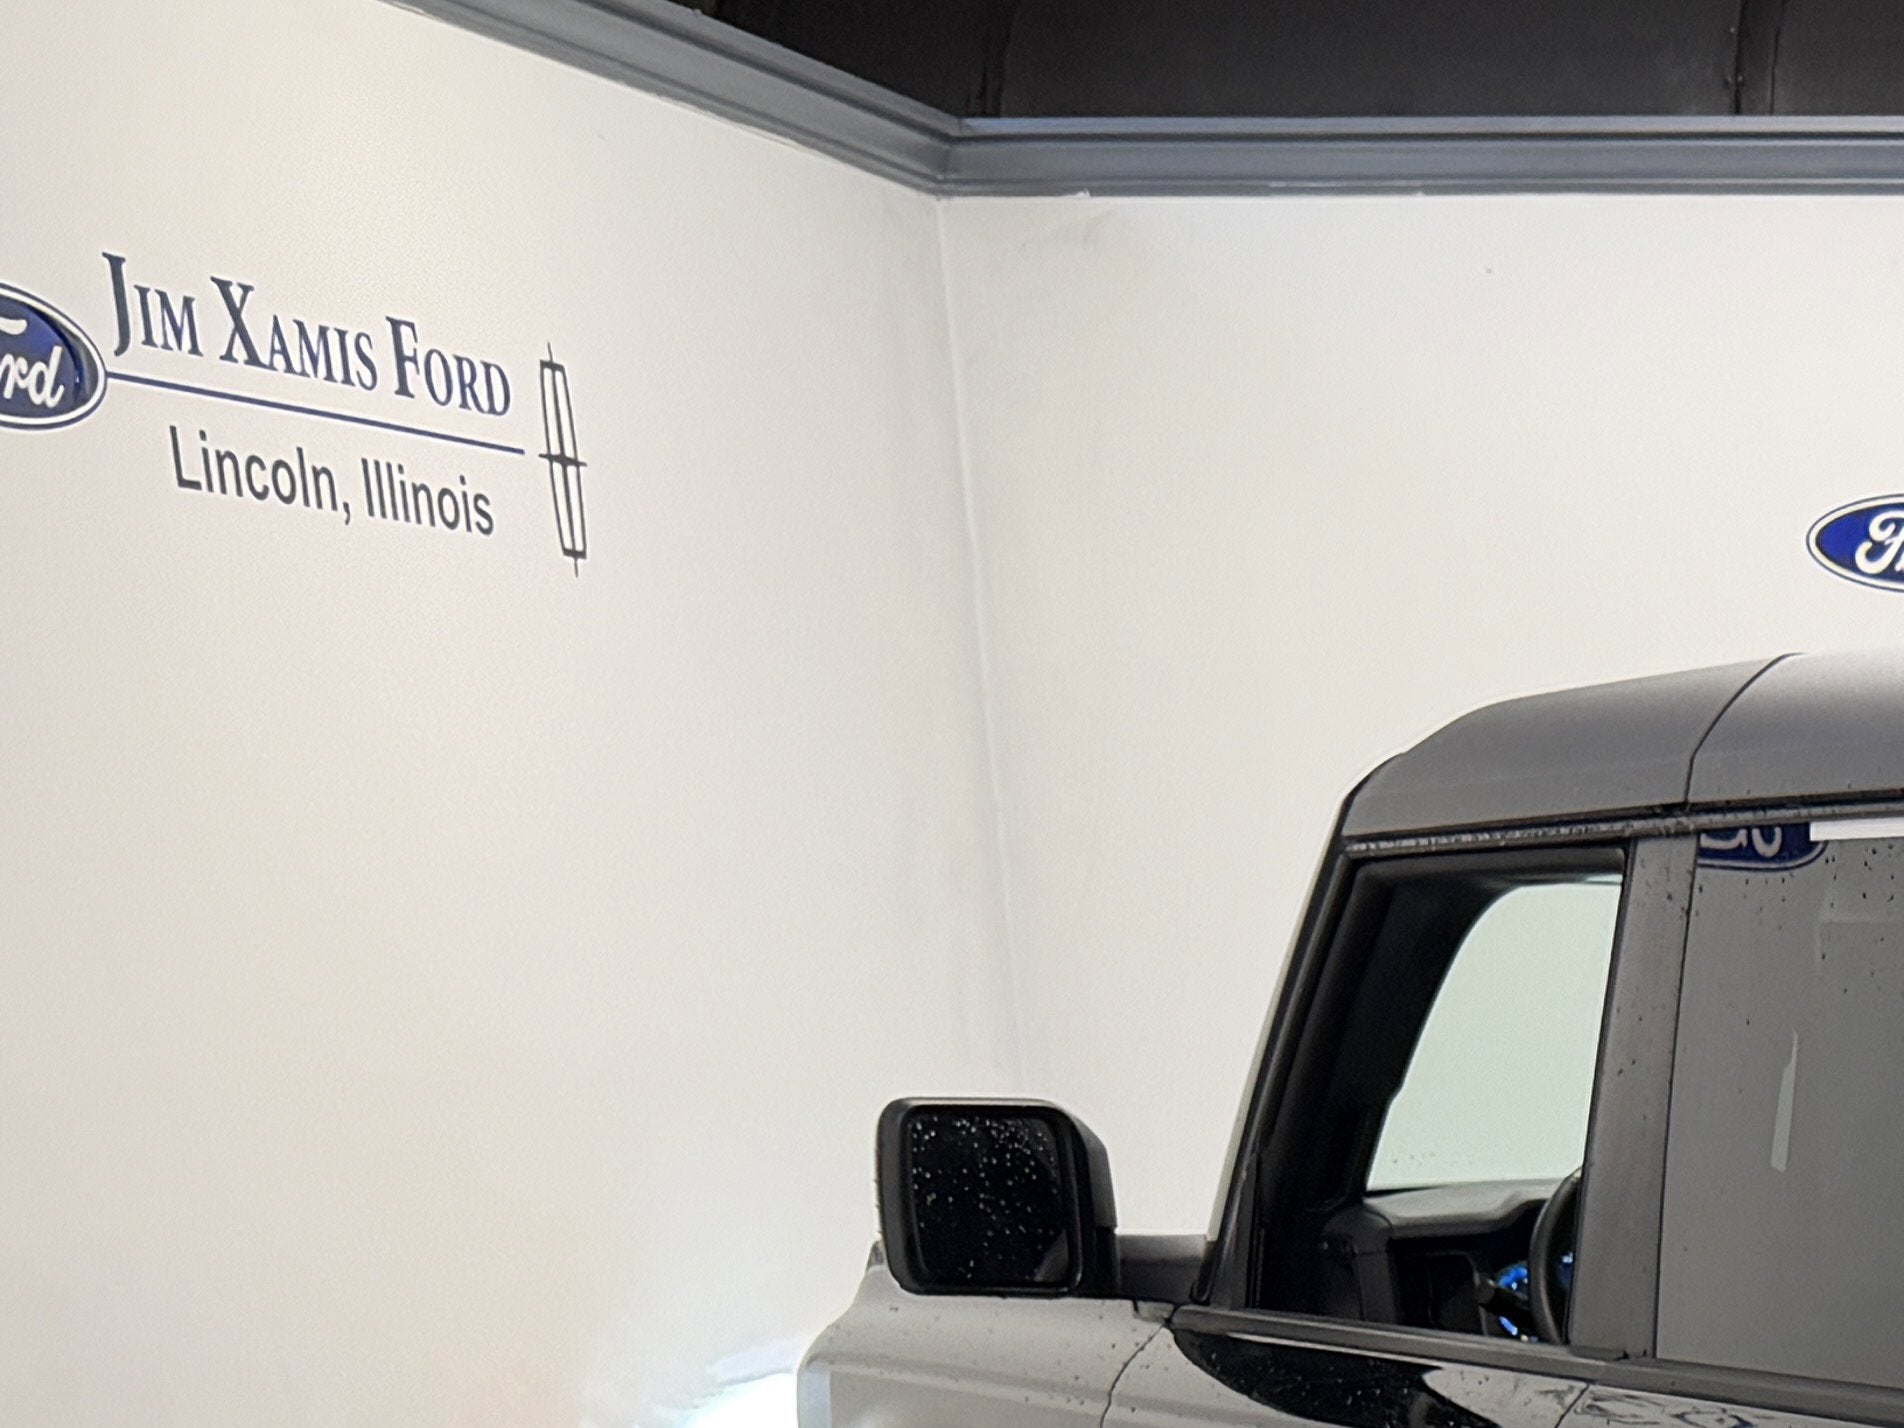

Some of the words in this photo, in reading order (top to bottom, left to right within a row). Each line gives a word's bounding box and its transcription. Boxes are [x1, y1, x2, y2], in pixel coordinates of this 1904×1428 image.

[0, 319, 64, 408] rd
[102, 252, 204, 358] JIM
[210, 276, 377, 392] XAMIS
[385, 315, 511, 418] FORD
[170, 425, 351, 525] Lincoln,
[361, 457, 494, 535] Illinois
